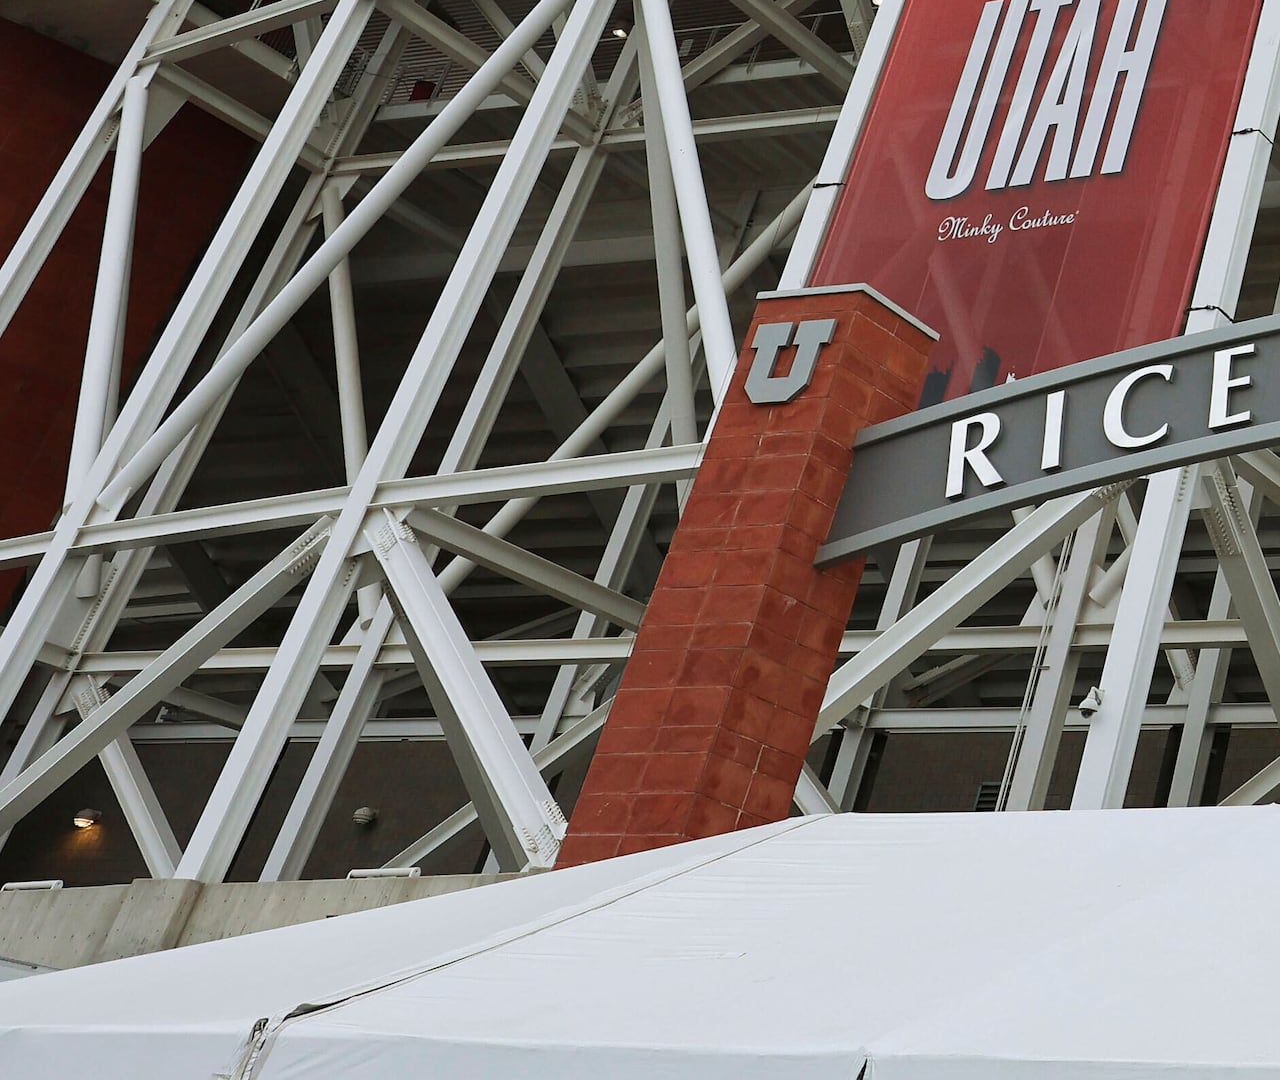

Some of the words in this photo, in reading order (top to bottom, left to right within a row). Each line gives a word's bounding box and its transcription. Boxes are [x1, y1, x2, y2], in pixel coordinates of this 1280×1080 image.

[937, 213, 1003, 244] Minky
[1009, 206, 1075, 231] Couture
[743, 318, 838, 406] U
